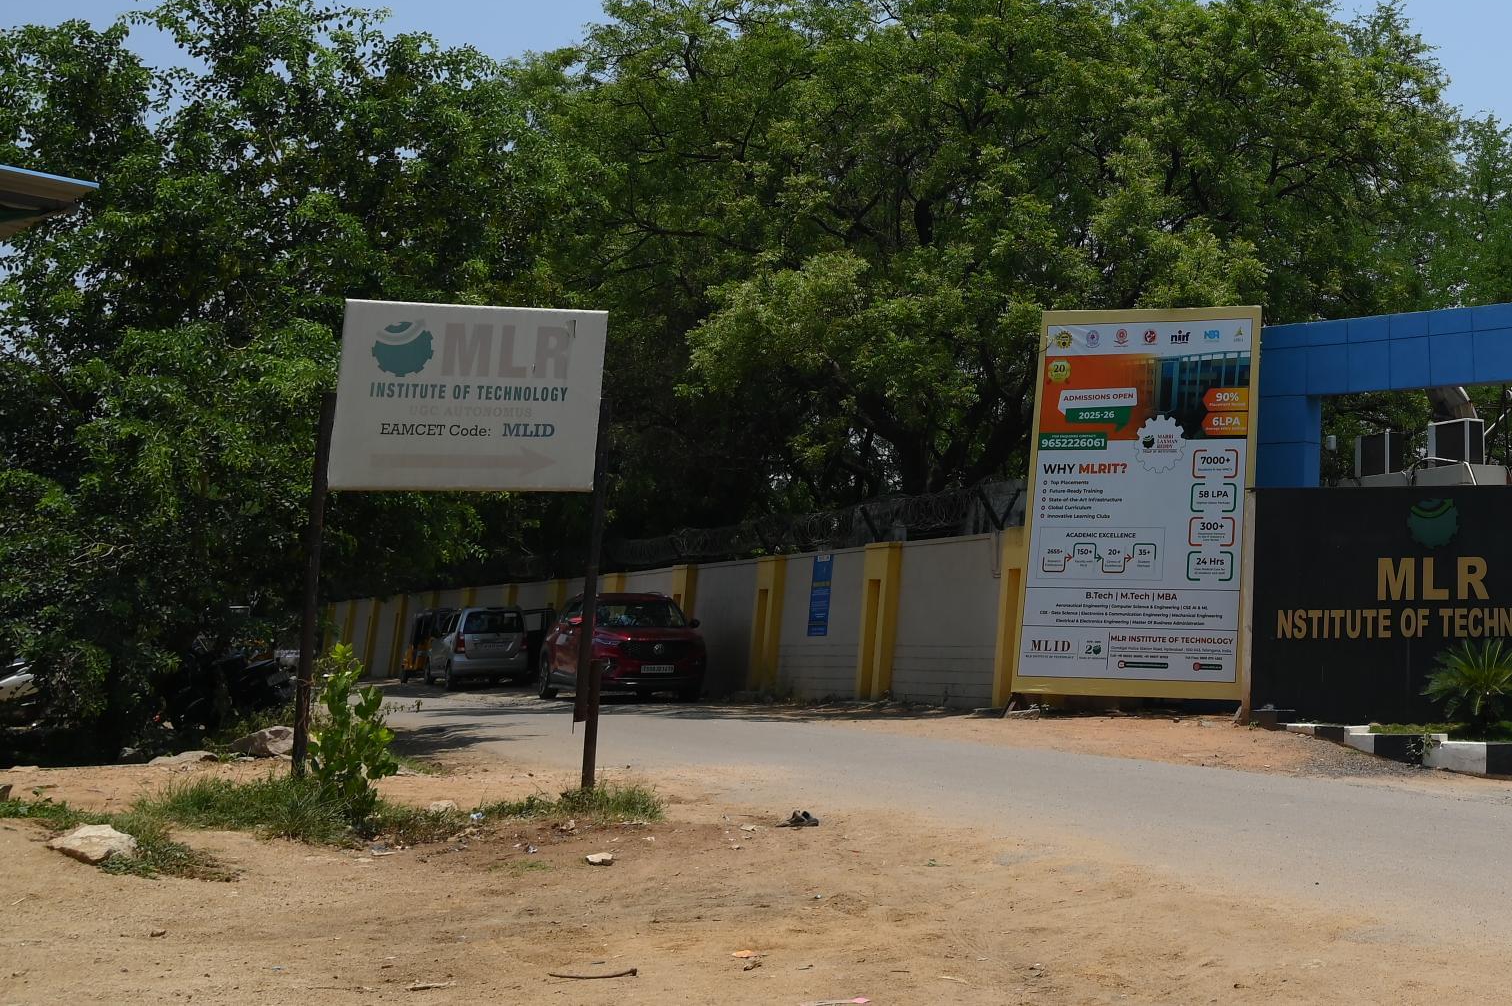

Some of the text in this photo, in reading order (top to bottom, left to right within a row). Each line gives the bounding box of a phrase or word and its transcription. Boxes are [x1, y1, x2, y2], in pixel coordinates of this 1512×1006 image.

[1170, 330, 1191, 343] nirf
[440, 322, 571, 380] MLR
[369, 382, 569, 402] INSTITUTE OF TECHNOLOGY
[1063, 392, 1134, 402] ADMISSIONS OPEN
[1216, 392, 1240, 402] 90%
[409, 405, 533, 418] UGC AUTONOMUS
[1078, 411, 1115, 420] 2025-26
[1212, 417, 1240, 426] 6LPA
[380, 423, 556, 438] EAMCET Code: MLID
[1041, 438, 1105, 447] 9652226061
[1200, 456, 1230, 465] 7000+
[1043, 463, 1128, 474] WHY MLRIT?
[1199, 490, 1229, 498] 58 LPA
[1200, 522, 1224, 530] 300+
[1376, 556, 1490, 601] MLR
[1086, 592, 1113, 600] B.Tech
[1120, 592, 1150, 600] M.Tech
[1276, 608, 1392, 640] NSTITUTE
[1400, 608, 1431, 638] OF
[1031, 640, 1071, 652] MLID
